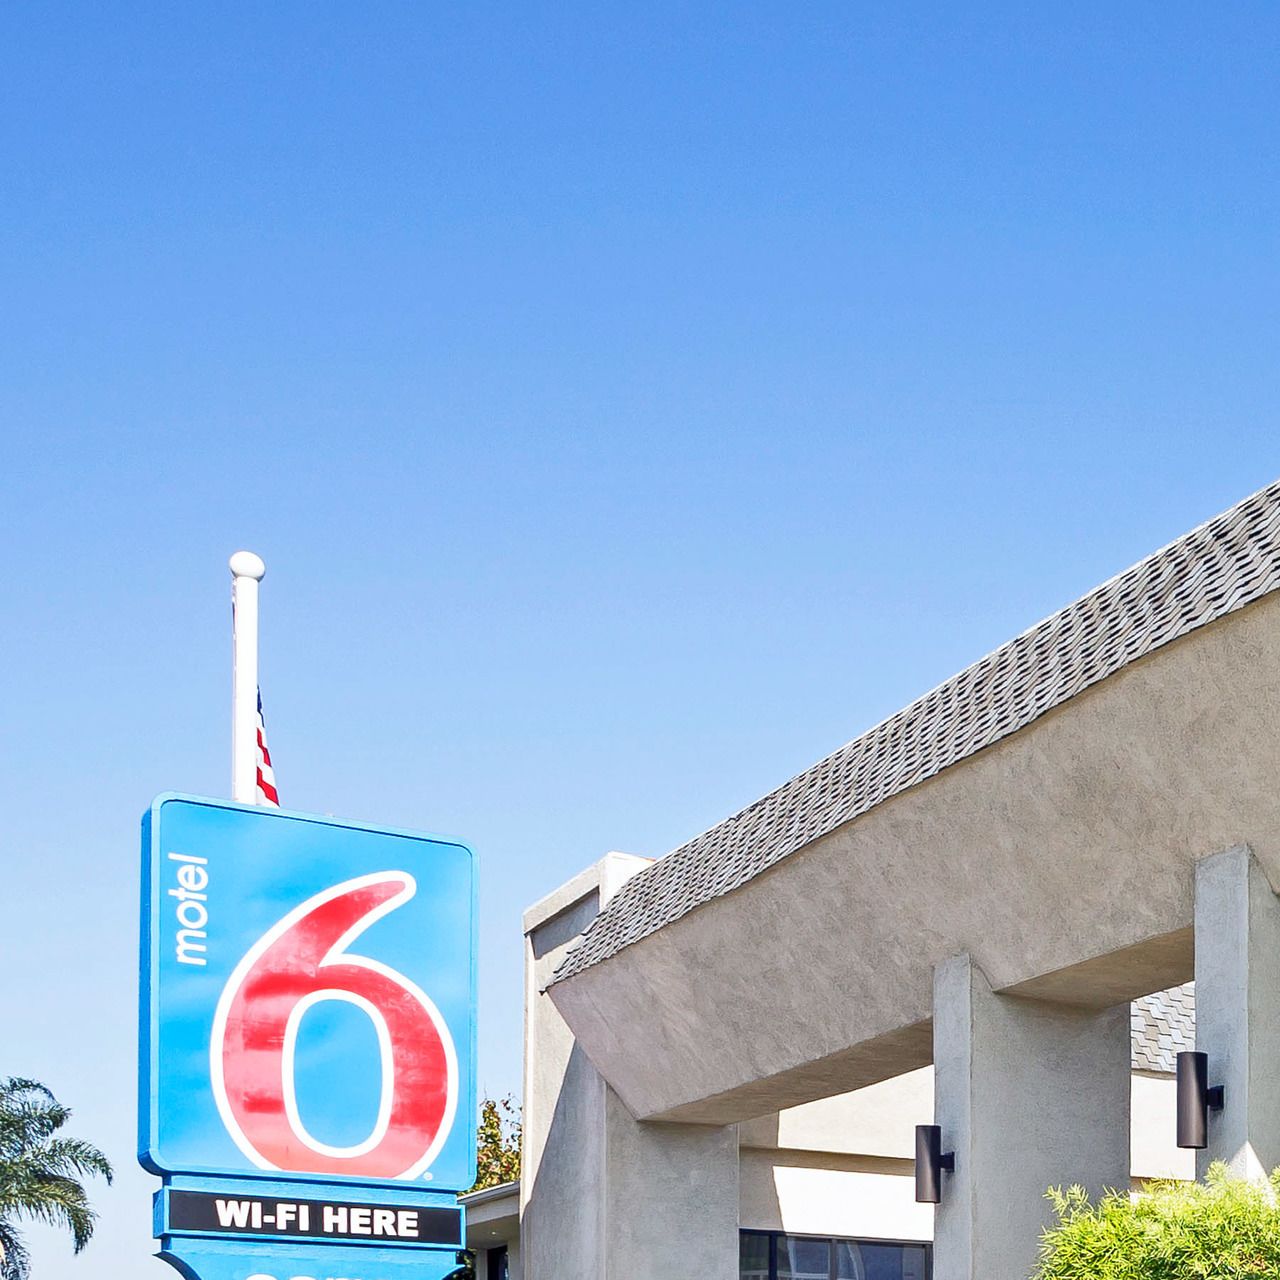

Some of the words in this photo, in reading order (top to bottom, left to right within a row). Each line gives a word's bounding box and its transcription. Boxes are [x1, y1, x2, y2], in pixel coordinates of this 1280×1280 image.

[167, 852, 208, 966] motel
[209, 870, 459, 1181] 6
[215, 1199, 310, 1232] WI-FI
[322, 1205, 419, 1238] HERE
